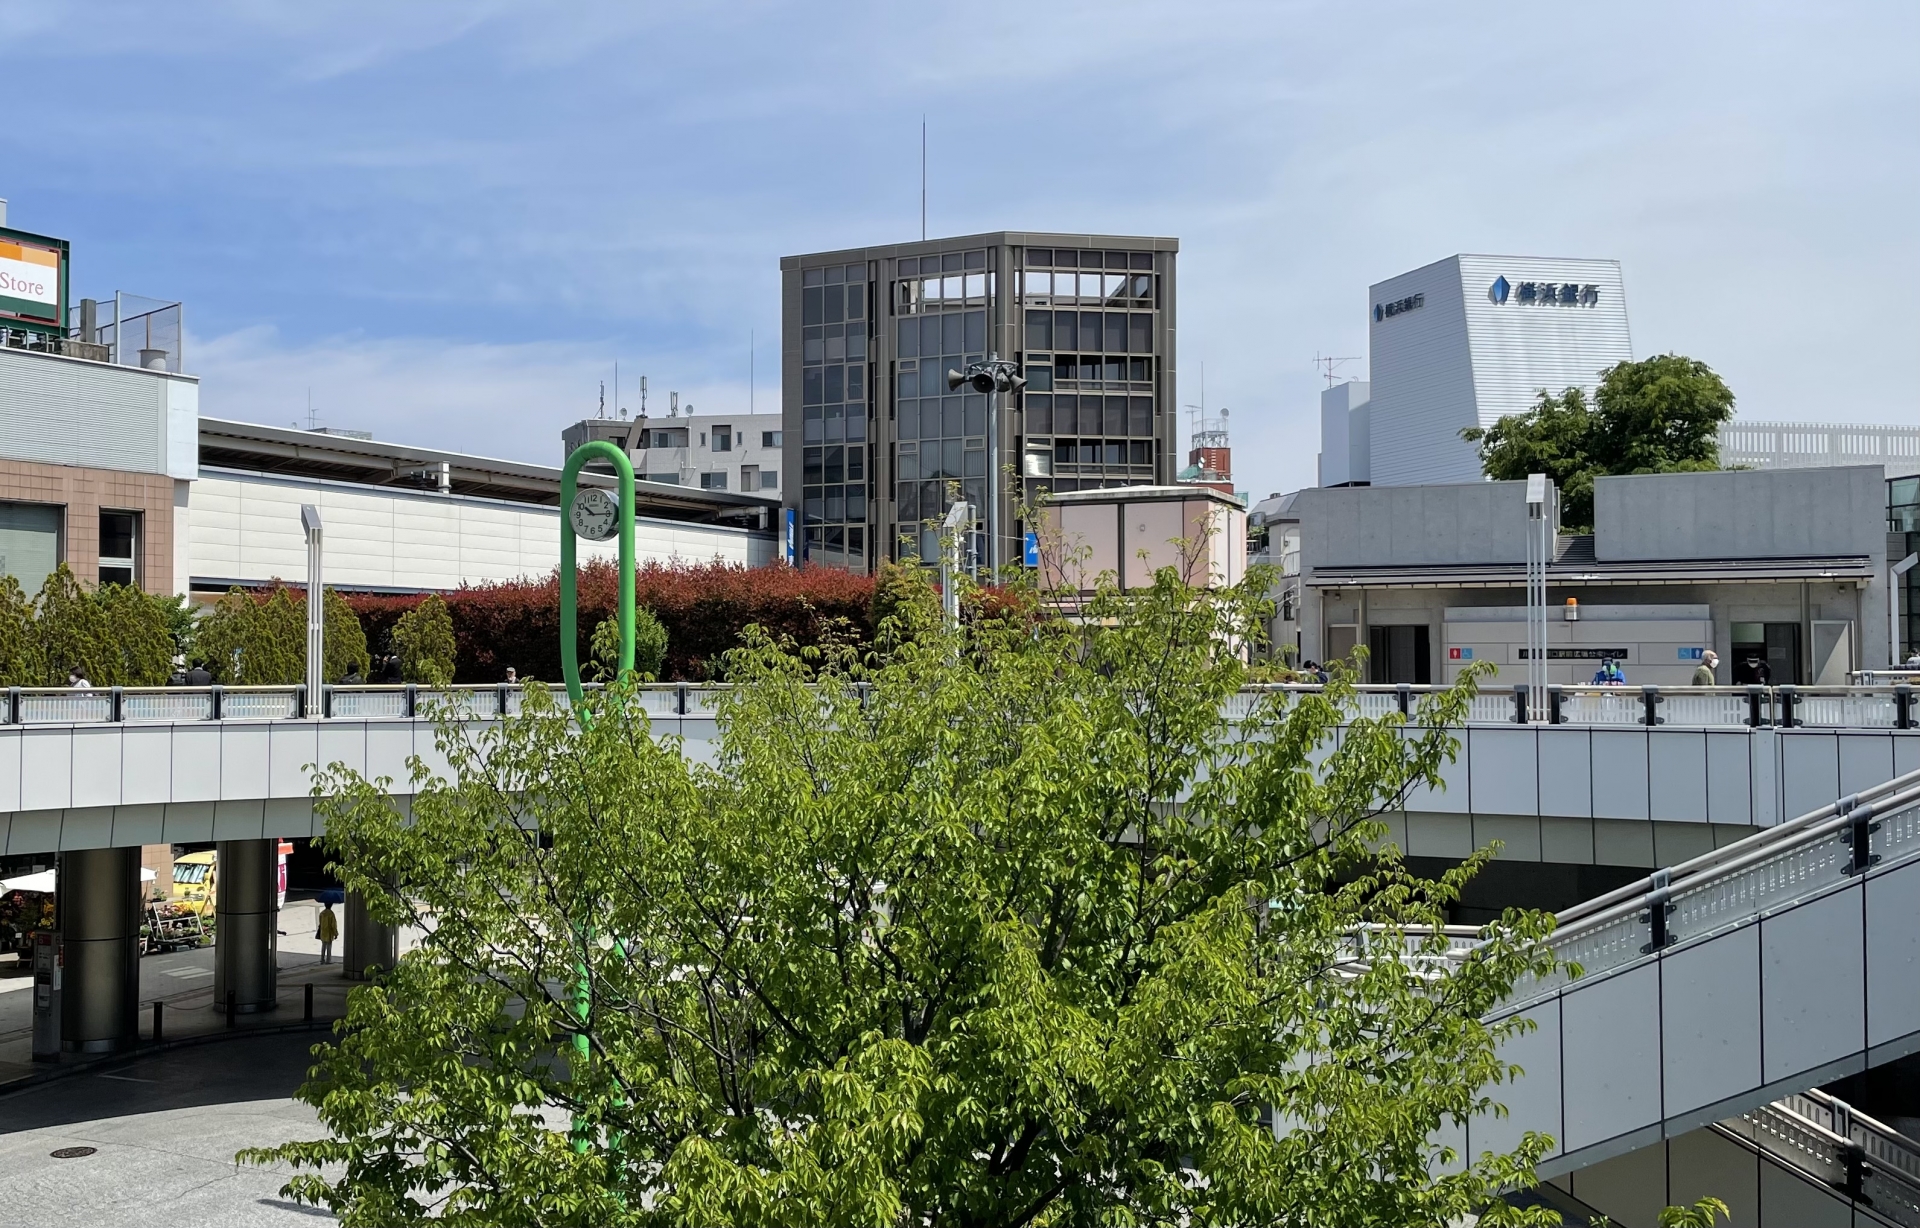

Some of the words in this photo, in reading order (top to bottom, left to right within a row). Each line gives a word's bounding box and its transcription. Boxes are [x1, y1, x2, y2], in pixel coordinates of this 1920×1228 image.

[0, 271, 44, 296] Store
[1516, 281, 1600, 306] 横浜銀行
